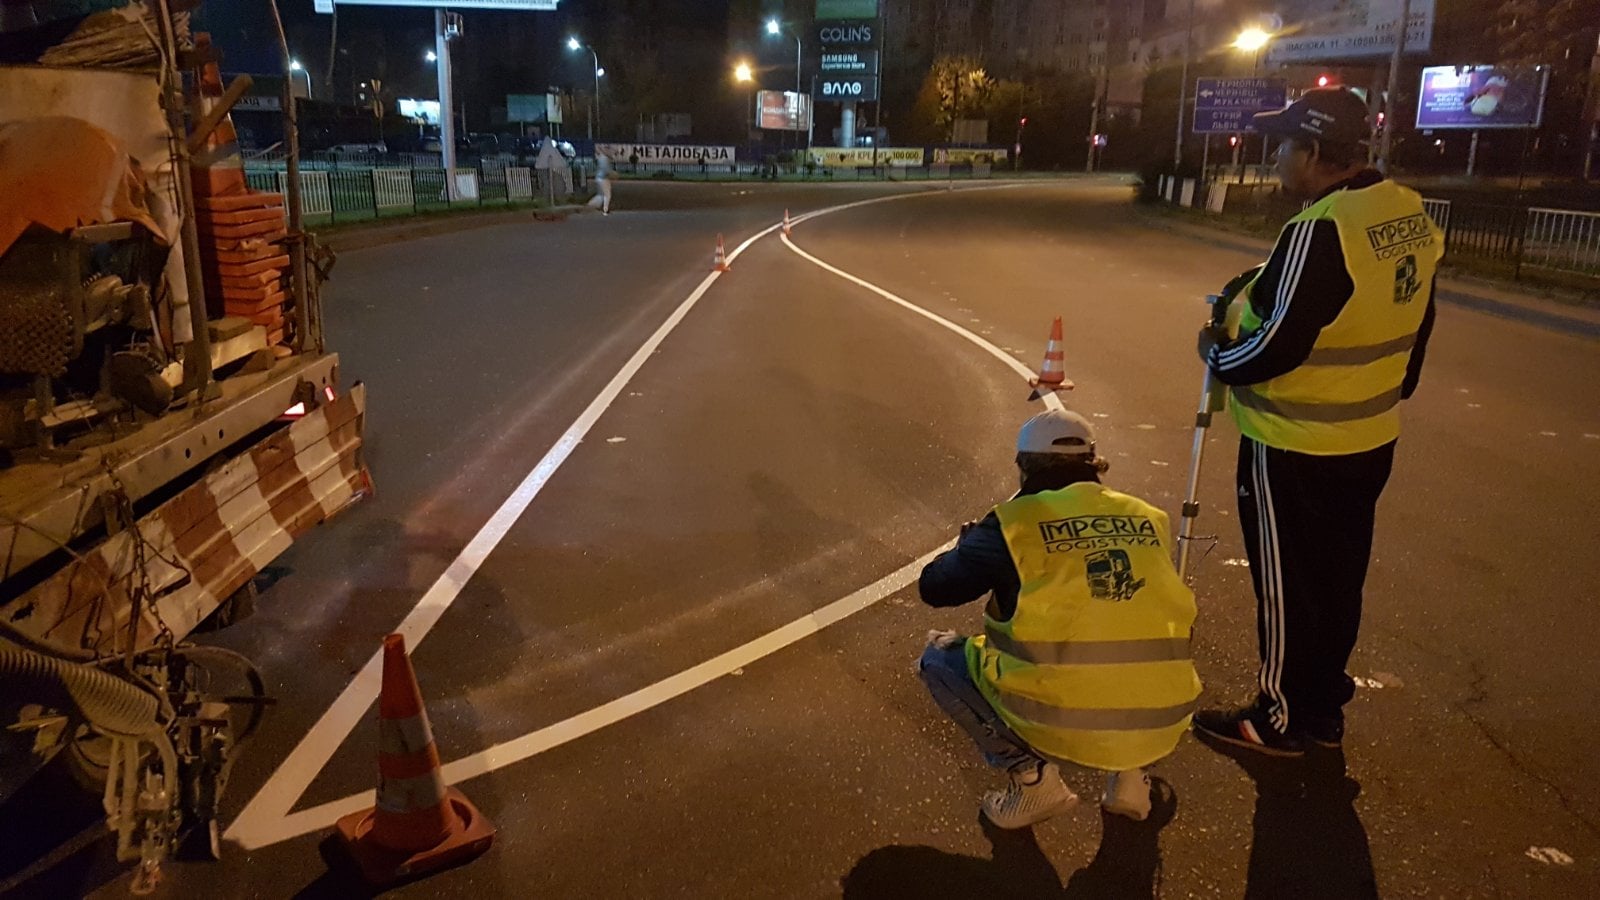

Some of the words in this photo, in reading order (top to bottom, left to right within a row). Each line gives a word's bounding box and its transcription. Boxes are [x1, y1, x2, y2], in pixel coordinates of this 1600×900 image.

[819, 25, 872, 42] COLIN'S
[821, 54, 858, 62] SAMSUNG
[633, 146, 728, 159] МЕТАЛОБАЗА
[1038, 517, 1156, 542] IMPERIA
[1046, 537, 1160, 554] LOGISTYKA
